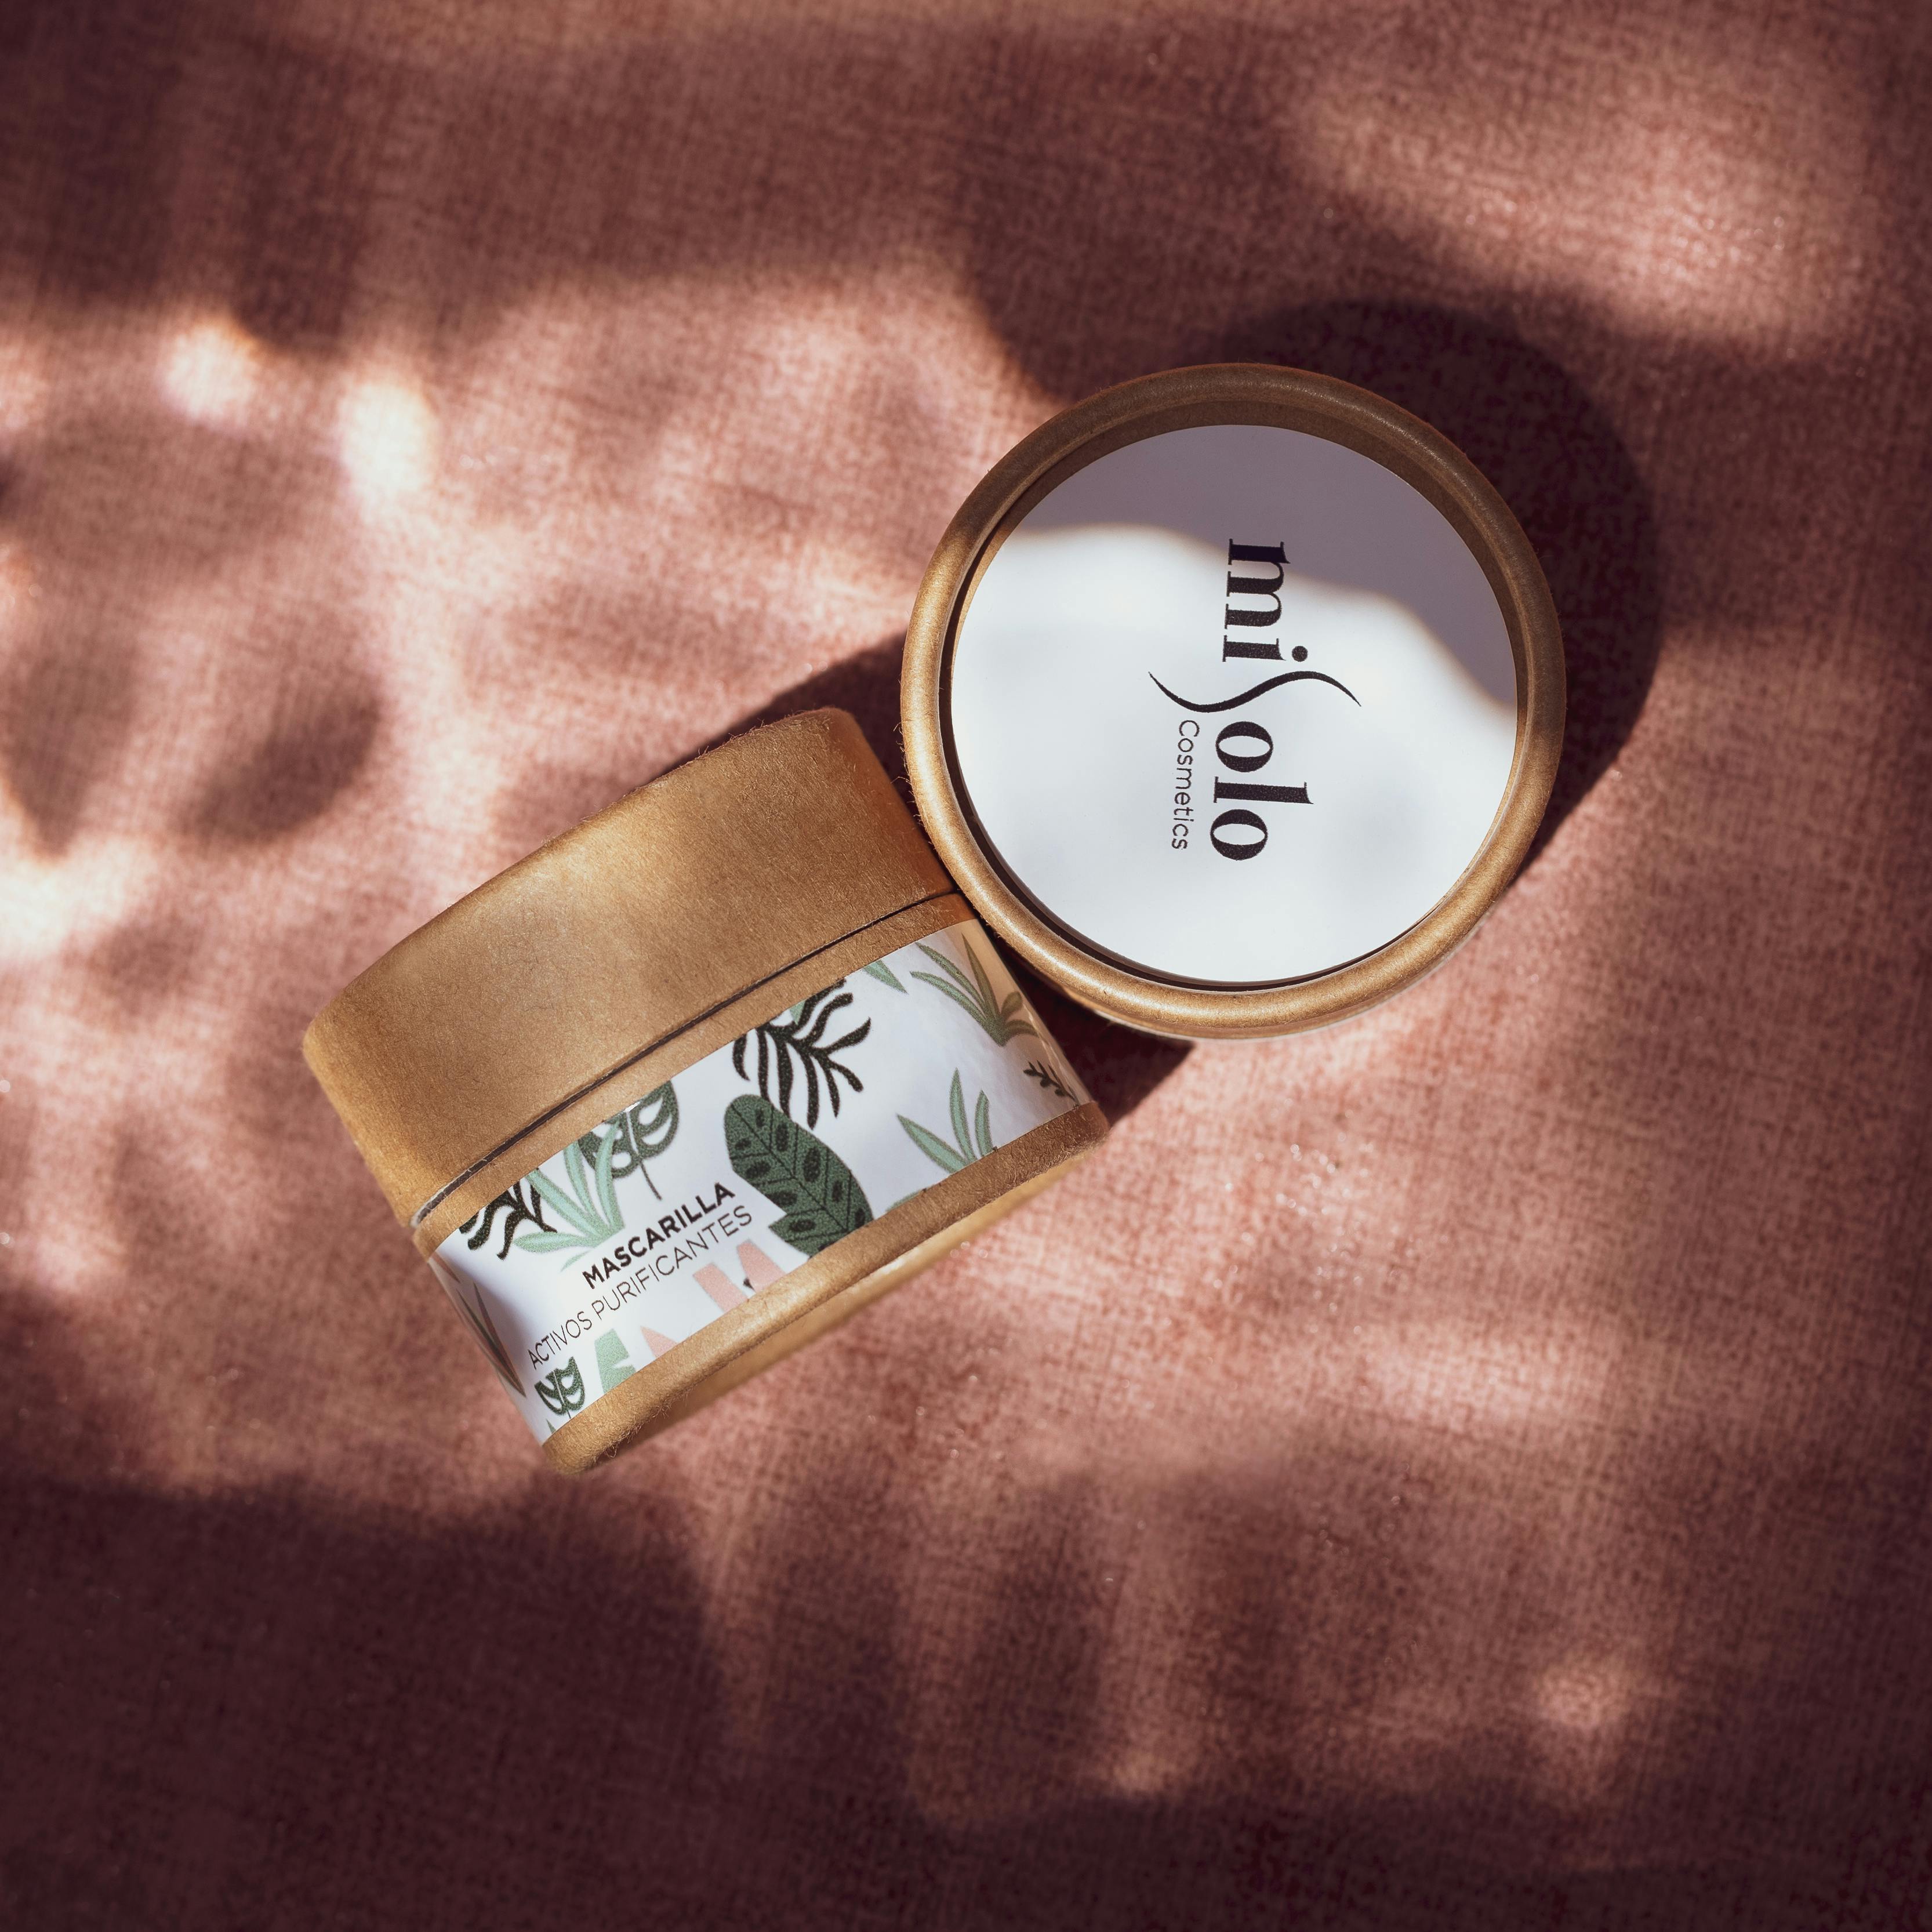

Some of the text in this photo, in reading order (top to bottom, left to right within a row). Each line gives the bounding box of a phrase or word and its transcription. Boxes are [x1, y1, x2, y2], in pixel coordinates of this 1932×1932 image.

[1171, 719, 1200, 851] Cosmetics
[527, 1205, 753, 1371] ACTIVOS PURIFICANTES
[582, 1182, 736, 1290] MASCARILLA
